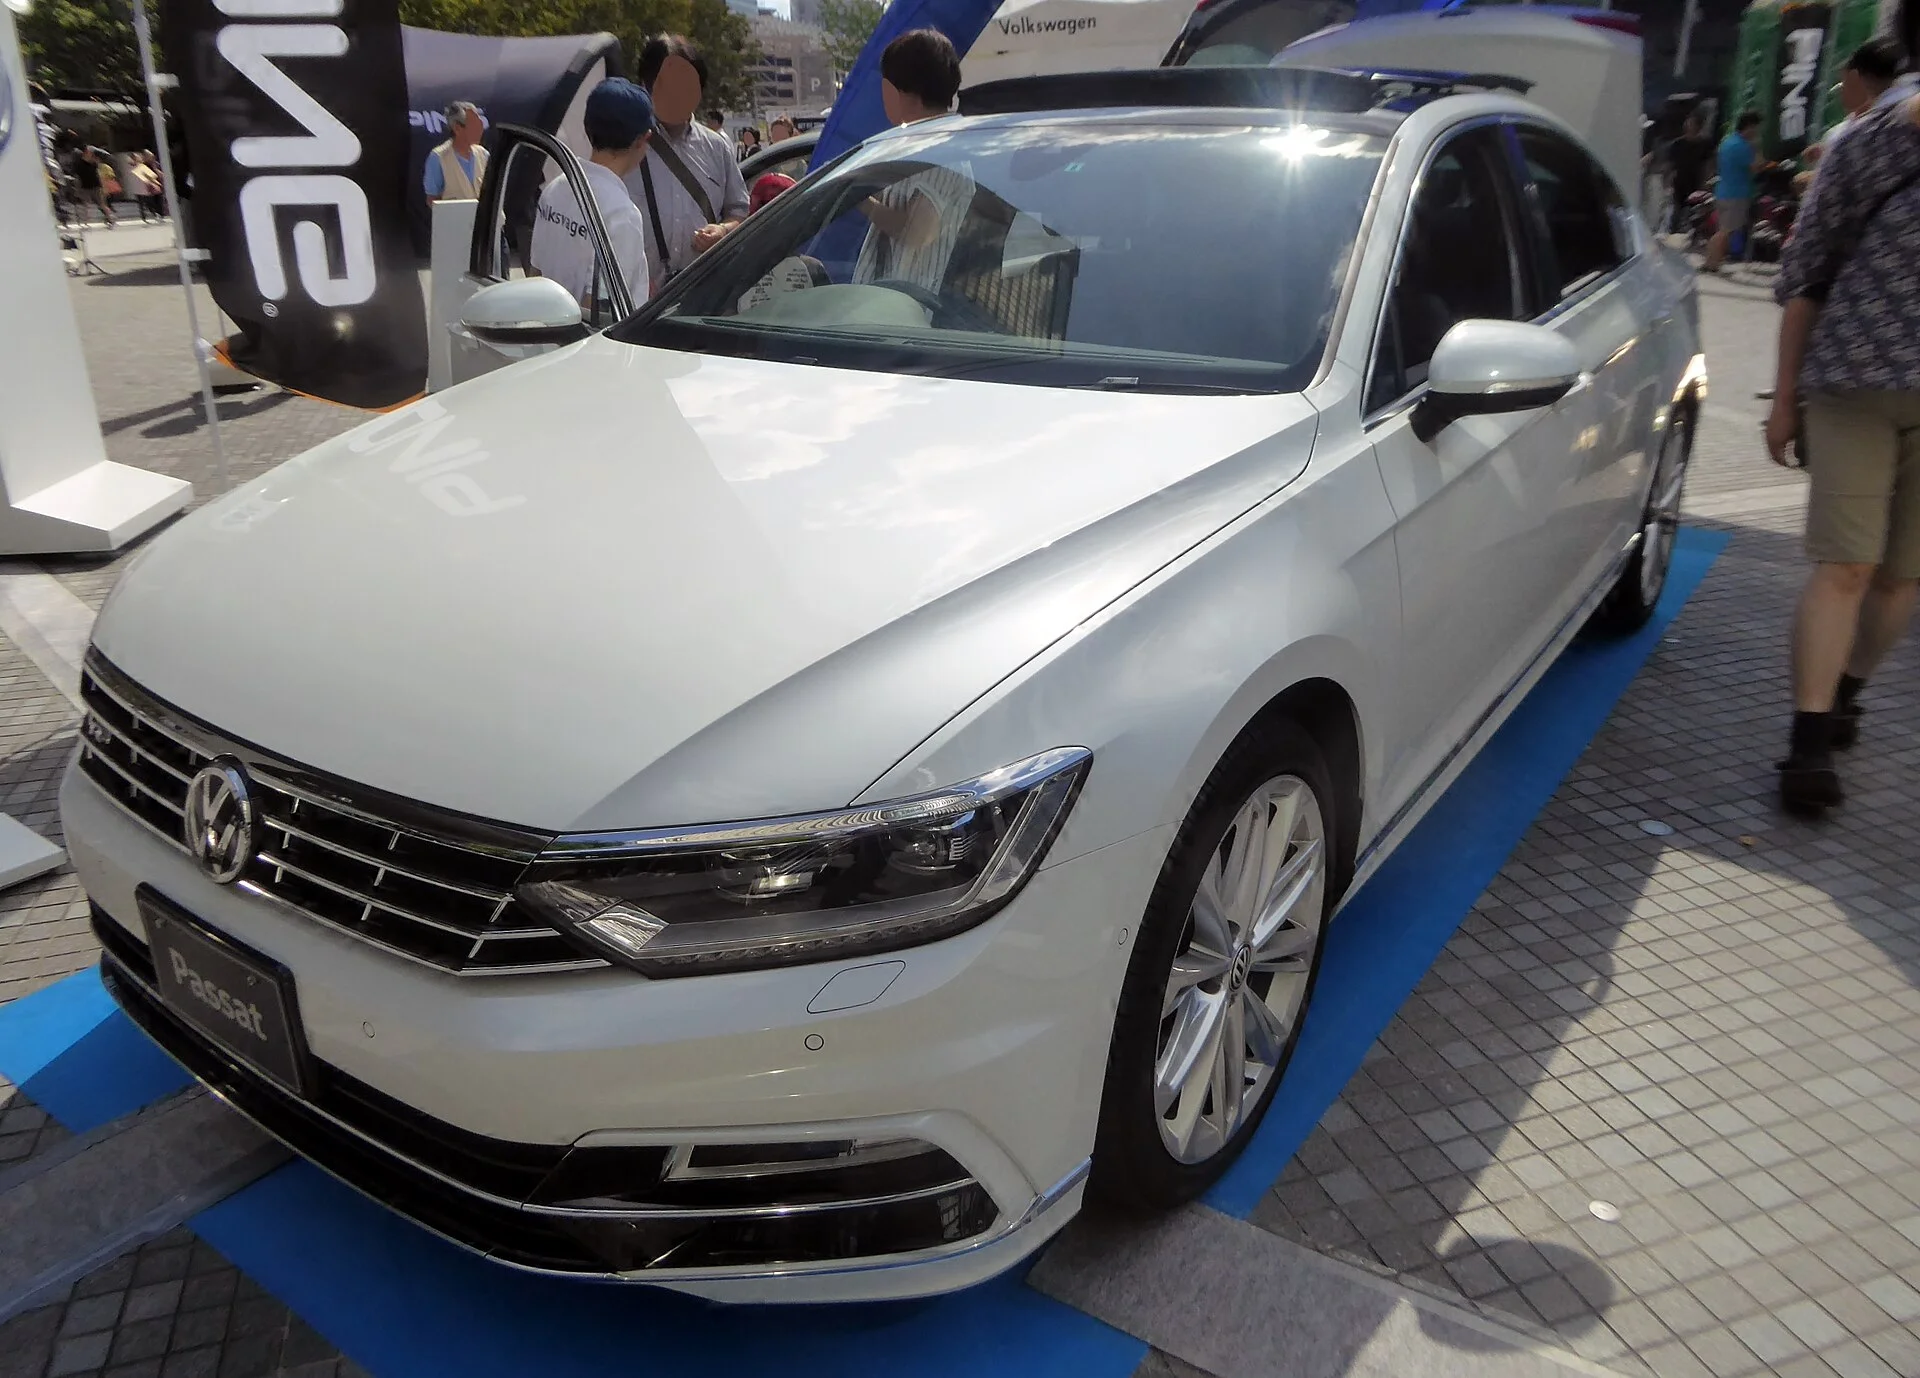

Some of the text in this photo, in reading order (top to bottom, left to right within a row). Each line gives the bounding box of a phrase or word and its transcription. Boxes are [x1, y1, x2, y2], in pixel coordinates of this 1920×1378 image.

[998, 15, 1097, 35] Volkswagen
[810, 77, 821, 92] P
[168, 947, 268, 1042] Passat
